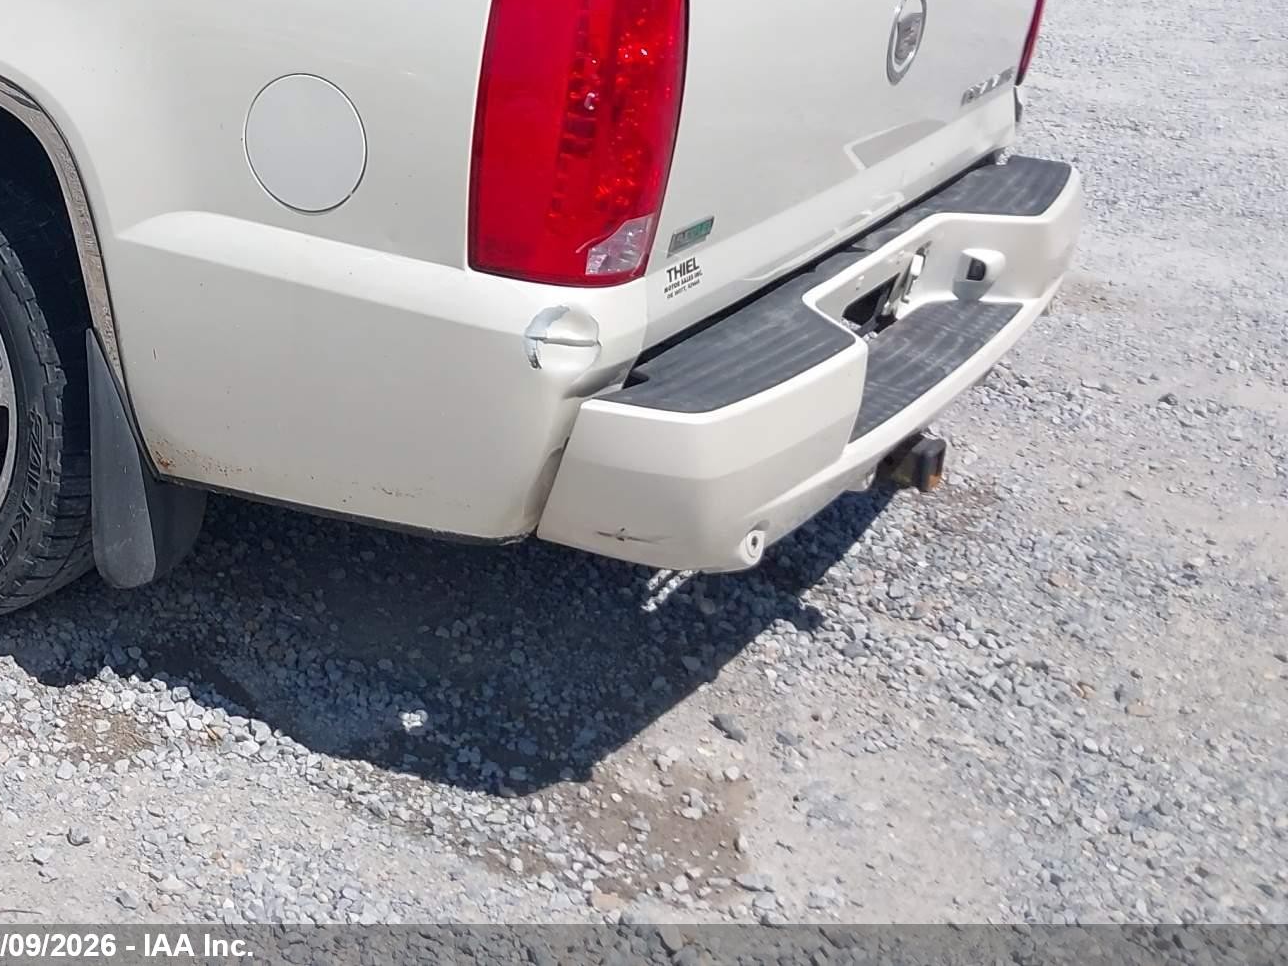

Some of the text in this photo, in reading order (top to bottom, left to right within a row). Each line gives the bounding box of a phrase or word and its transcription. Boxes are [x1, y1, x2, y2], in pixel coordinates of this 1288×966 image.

[666, 257, 700, 282] THIEL
[664, 281, 680, 293] MOTOR
[681, 273, 694, 284] SALES
